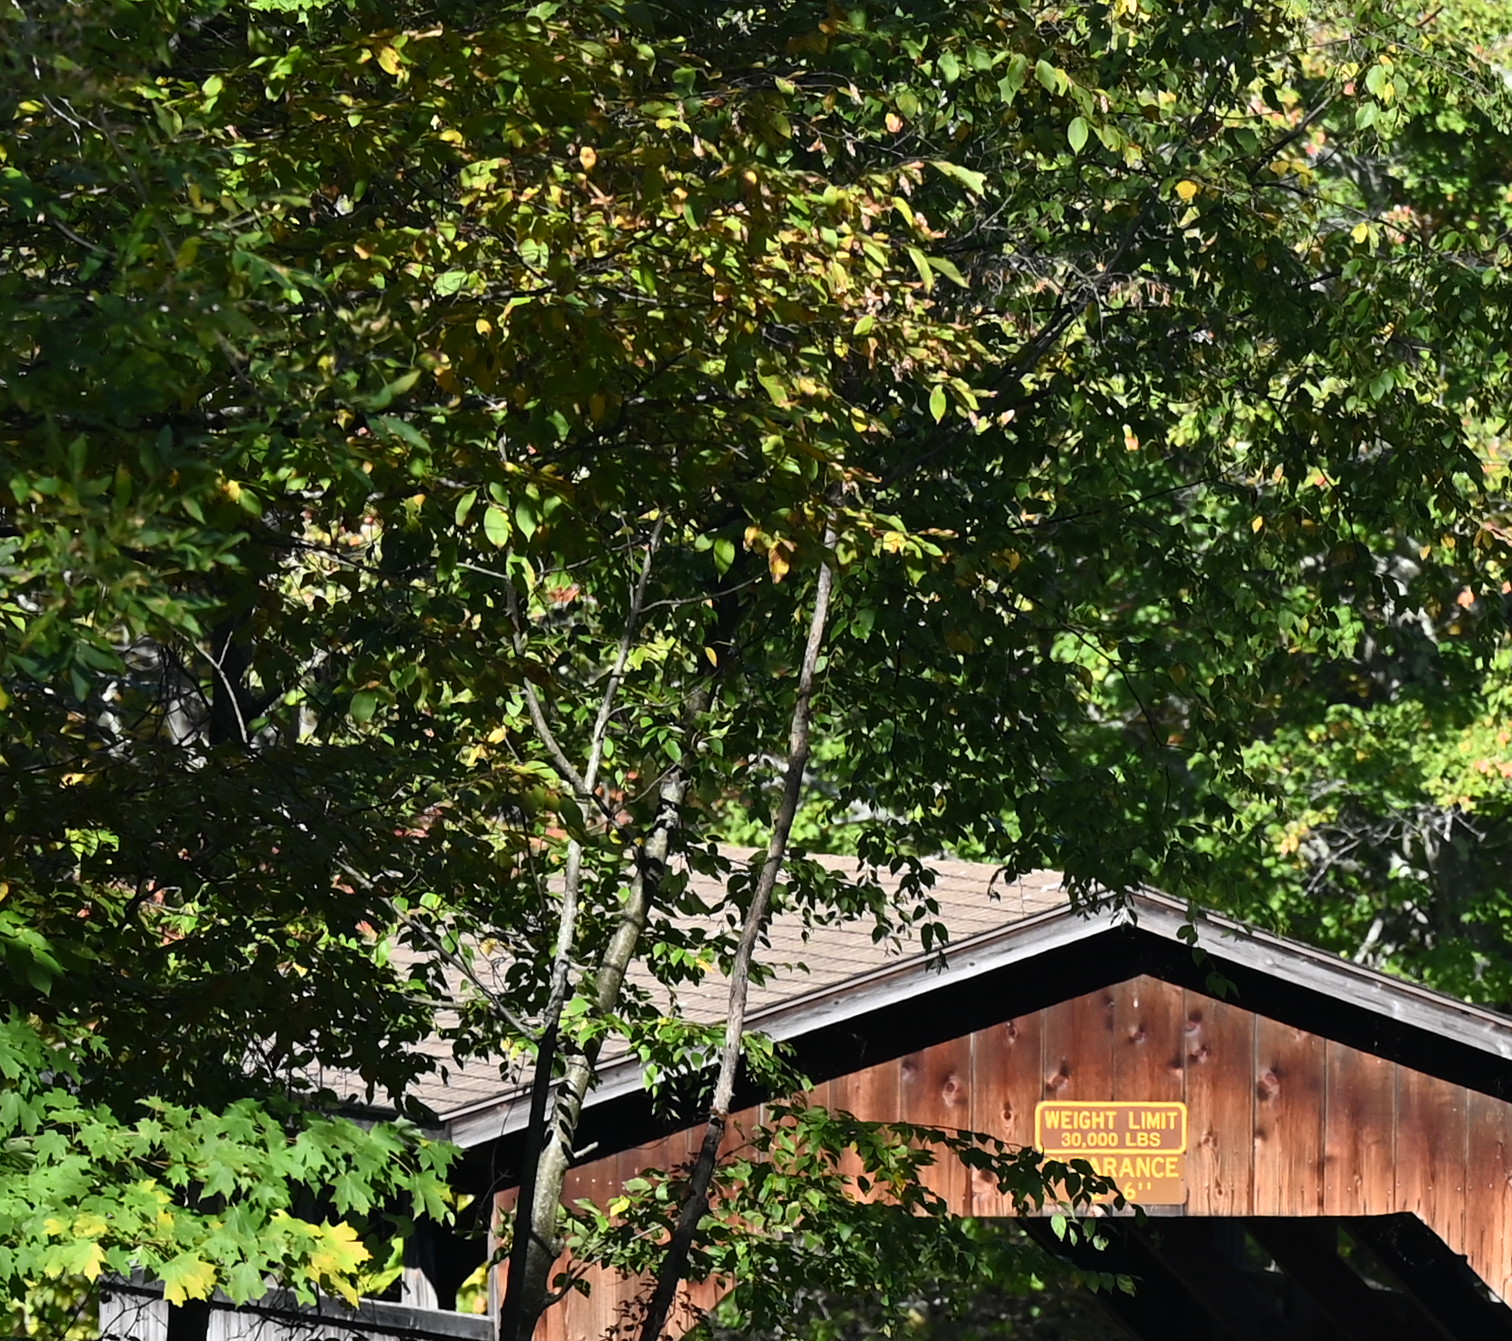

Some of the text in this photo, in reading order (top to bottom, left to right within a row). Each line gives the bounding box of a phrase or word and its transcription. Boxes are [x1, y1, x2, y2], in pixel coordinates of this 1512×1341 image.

[1044, 1111, 1178, 1129] WEIGHT LIMIT
[1060, 1132, 1161, 1148] 30,000 LBS
